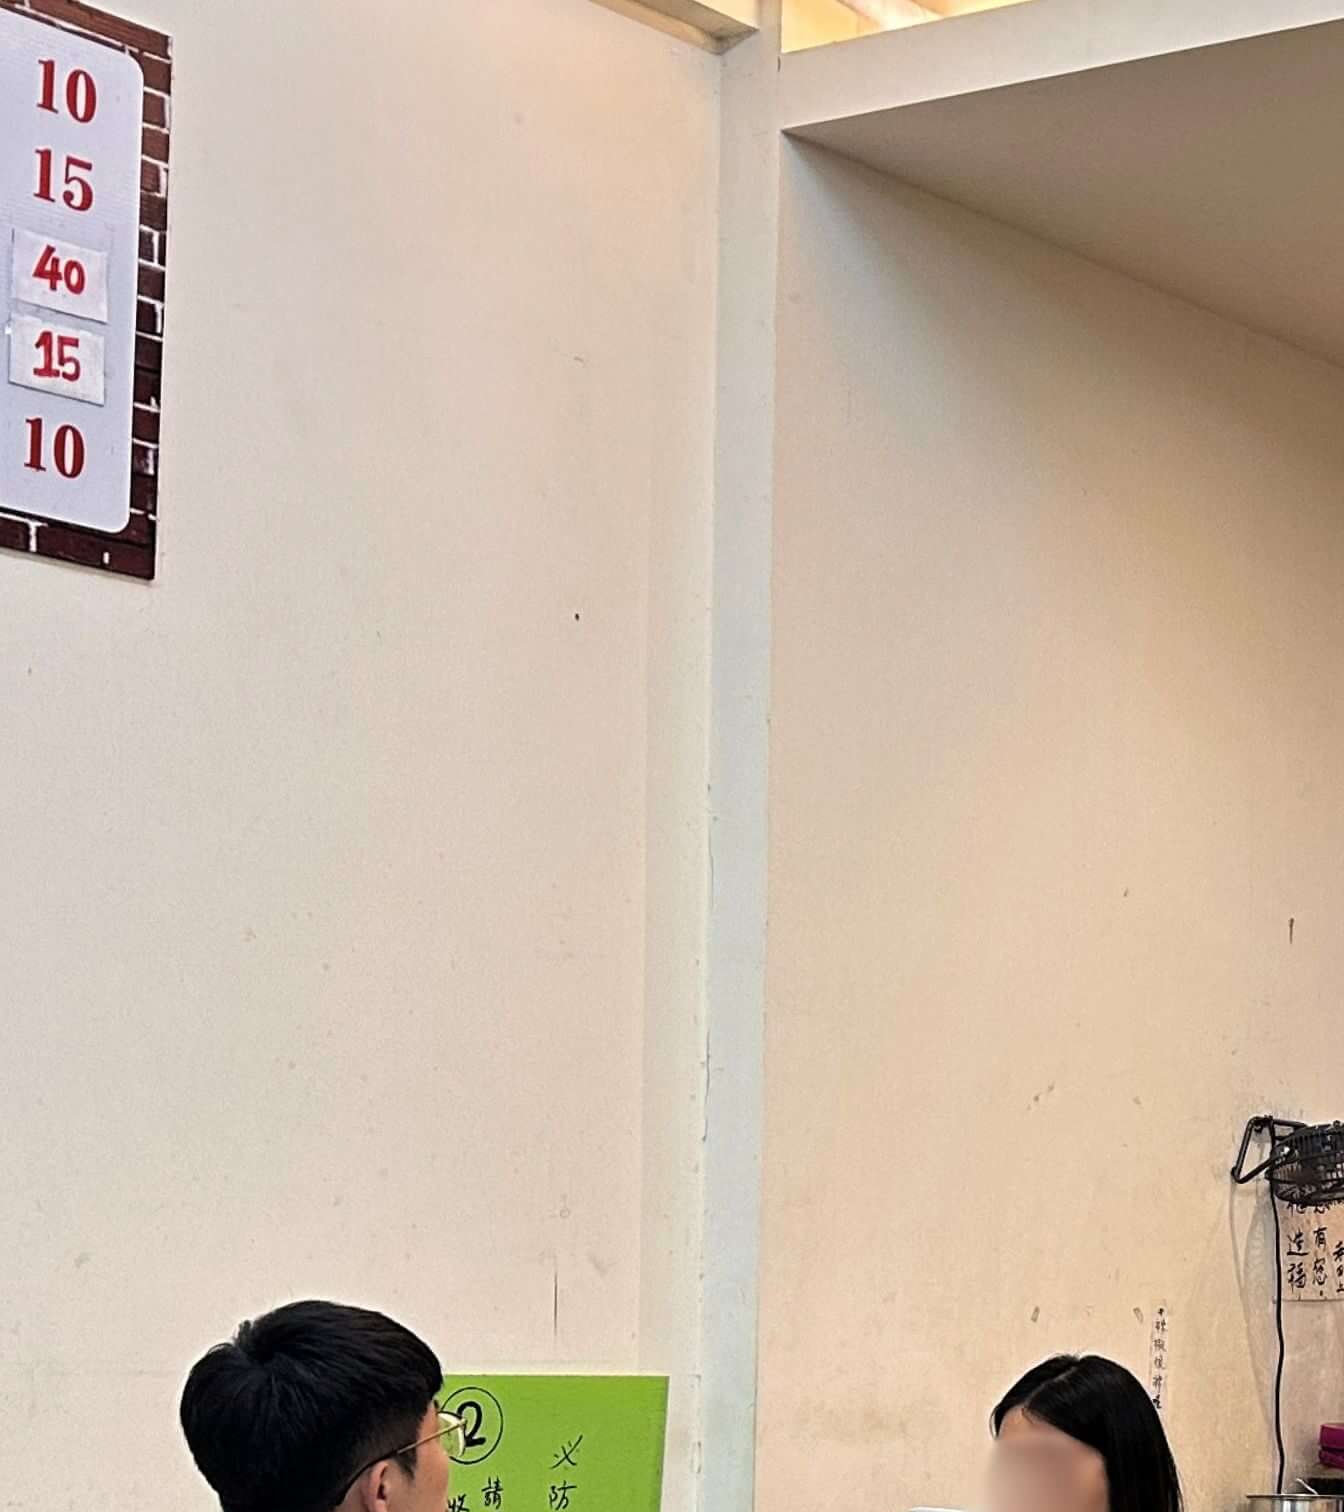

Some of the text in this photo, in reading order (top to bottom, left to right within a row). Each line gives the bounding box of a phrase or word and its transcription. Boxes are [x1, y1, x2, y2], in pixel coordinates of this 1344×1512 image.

[36, 59, 97, 124] 10
[33, 148, 94, 212] 15
[32, 245, 86, 295] 40
[32, 329, 82, 382] 15
[22, 417, 85, 480] 10
